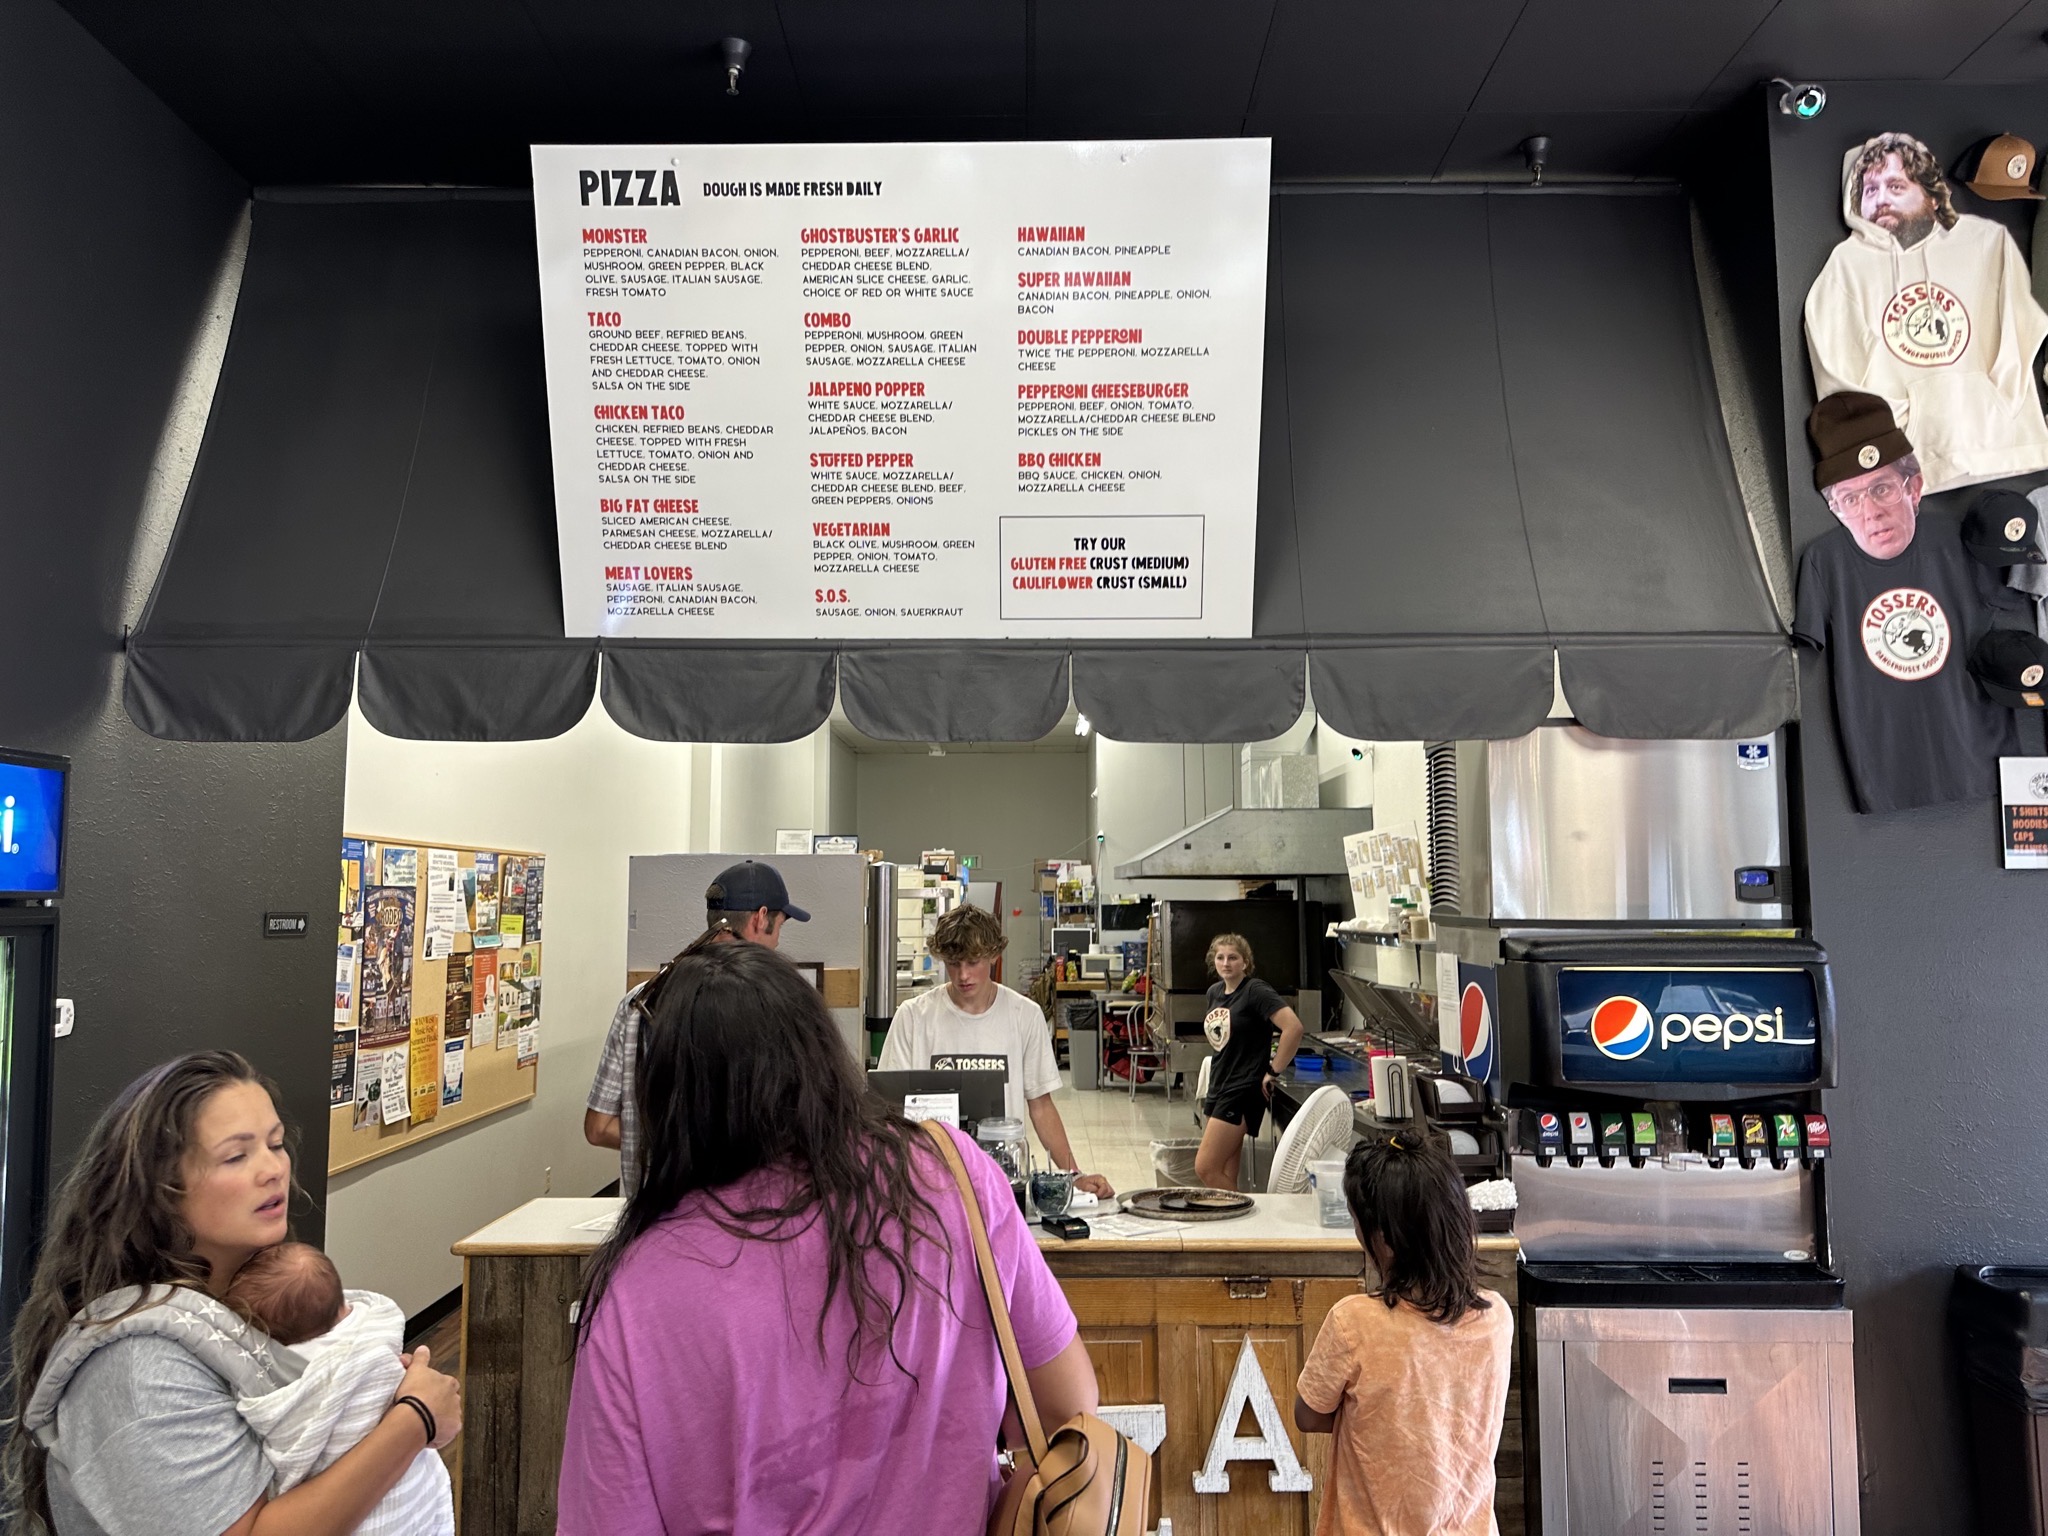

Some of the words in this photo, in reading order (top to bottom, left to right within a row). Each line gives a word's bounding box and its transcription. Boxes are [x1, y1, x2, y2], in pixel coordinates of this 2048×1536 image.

[579, 170, 680, 206] PIZZA
[704, 182, 746, 197] DOUGH
[750, 182, 762, 196] IS
[766, 182, 800, 196] MADE
[804, 182, 843, 196] FRESH
[846, 182, 882, 196] DAILY
[582, 228, 647, 244] MONSTER
[801, 228, 910, 244] GHOSTBUSTER'S
[914, 228, 959, 243] GARLIC
[1018, 226, 1085, 242] HAWAIIAN
[1018, 247, 1069, 256] CANADIAN
[1115, 245, 1170, 255] PINEAPPLE
[648, 262, 682, 270] GREEN
[731, 262, 764, 270] BLACK
[803, 275, 853, 284] AMERICAN
[857, 275, 884, 284] SLICE
[1018, 272, 1060, 288] SUPER
[1064, 271, 1131, 286] HAWAIIAN
[586, 288, 618, 296] FRESH
[622, 288, 666, 297] TOMATO
[803, 288, 840, 297] CHOICE
[844, 288, 858, 297] OF
[862, 288, 882, 297] RED
[886, 288, 900, 297] OR
[905, 288, 937, 297] WHITE
[941, 288, 973, 297] SAUCE
[1018, 305, 1054, 314] BACON
[588, 312, 621, 327] TACO
[804, 312, 851, 328] COMBO
[1018, 329, 1068, 345] DOUBLE
[1072, 329, 1142, 344] PEPPERONI
[590, 343, 638, 351] CHEDDAR
[686, 343, 727, 352] TOPPED
[732, 343, 758, 352] WITH
[1018, 349, 1050, 358] TWICE
[1055, 349, 1074, 358] THE
[1141, 347, 1209, 357] MOZZARELLA
[1018, 362, 1056, 371] CHEESE
[592, 369, 612, 377] AND
[616, 369, 664, 378] CHEDDAR
[592, 381, 624, 390] SALSA
[628, 382, 642, 390] ON
[646, 382, 665, 390] THE
[669, 382, 690, 390] SIDE
[808, 382, 872, 397] JALAPENO
[875, 382, 925, 397] POPPER
[1018, 384, 1088, 399] PEPPERONI
[1092, 383, 1188, 398] CHEESEBURGER
[808, 401, 840, 410] WHITE
[881, 401, 952, 410] MOZZARELLA/
[594, 405, 648, 420] CHICKEN
[651, 406, 684, 420] TACO
[1018, 414, 1137, 424] MOZZARELLA/CHEDDAR
[1141, 414, 1179, 423] CHEESE
[1183, 413, 1215, 422] BLEND
[872, 426, 907, 435] BACON
[1018, 427, 1058, 436] PICKLES
[1062, 427, 1076, 436] ON
[1080, 427, 1098, 436] THE
[1102, 427, 1123, 436] SIDE
[640, 438, 681, 446] TOPPED
[685, 438, 711, 446] WITH
[715, 438, 746, 447] FRESH
[810, 453, 863, 467] STUFFED
[867, 453, 913, 467] PEPPER
[1018, 453, 1045, 468] BBQ
[1049, 452, 1101, 467] CHICKEN
[599, 475, 630, 483] SALSA
[634, 475, 648, 483] ON
[652, 475, 671, 483] THE
[675, 475, 696, 484] SIDE
[1018, 484, 1084, 492] MOZZARELLA
[1088, 483, 1125, 492] CHEESE
[600, 499, 622, 513] BIG
[626, 499, 649, 513] FAT
[654, 499, 698, 513] CHEESE
[812, 496, 844, 504] GREEN
[897, 496, 933, 505] ONIONS
[602, 517, 636, 525] SLICED
[640, 517, 688, 525] AMERICAN
[813, 523, 890, 537] VEGETARIAN
[604, 541, 650, 550] CHEDDAR
[654, 541, 692, 550] CHEESE
[695, 542, 727, 550] BLEND
[1074, 538, 1097, 550] TRY
[1101, 538, 1125, 550] OUR
[814, 564, 879, 572] MOZZARELLA
[883, 564, 919, 572] CHEESE
[1011, 558, 1056, 570] GLUTEN
[1059, 557, 1086, 570] FREE
[1090, 557, 1128, 570] CRUST
[1132, 557, 1189, 569] (MEDIUM)
[605, 566, 640, 580] MEAT
[644, 566, 692, 580] LOVERS
[1013, 576, 1092, 589] CAULIFLOWER
[1097, 576, 1135, 589] CRUST
[1138, 576, 1186, 589] (SMALL)
[815, 589, 850, 603] S.O.S.
[608, 607, 674, 615] MOZZARELLA
[678, 607, 714, 616] CHEESE
[901, 608, 963, 616] SAUERKRAUT
[1866, 592, 1938, 629] TOSSERS
[2014, 831, 2034, 841] CAPS
[269, 918, 297, 930] RESTROOM
[1660, 1006, 1814, 1051] pepsi
[956, 1058, 1005, 1071] TOSSERS
